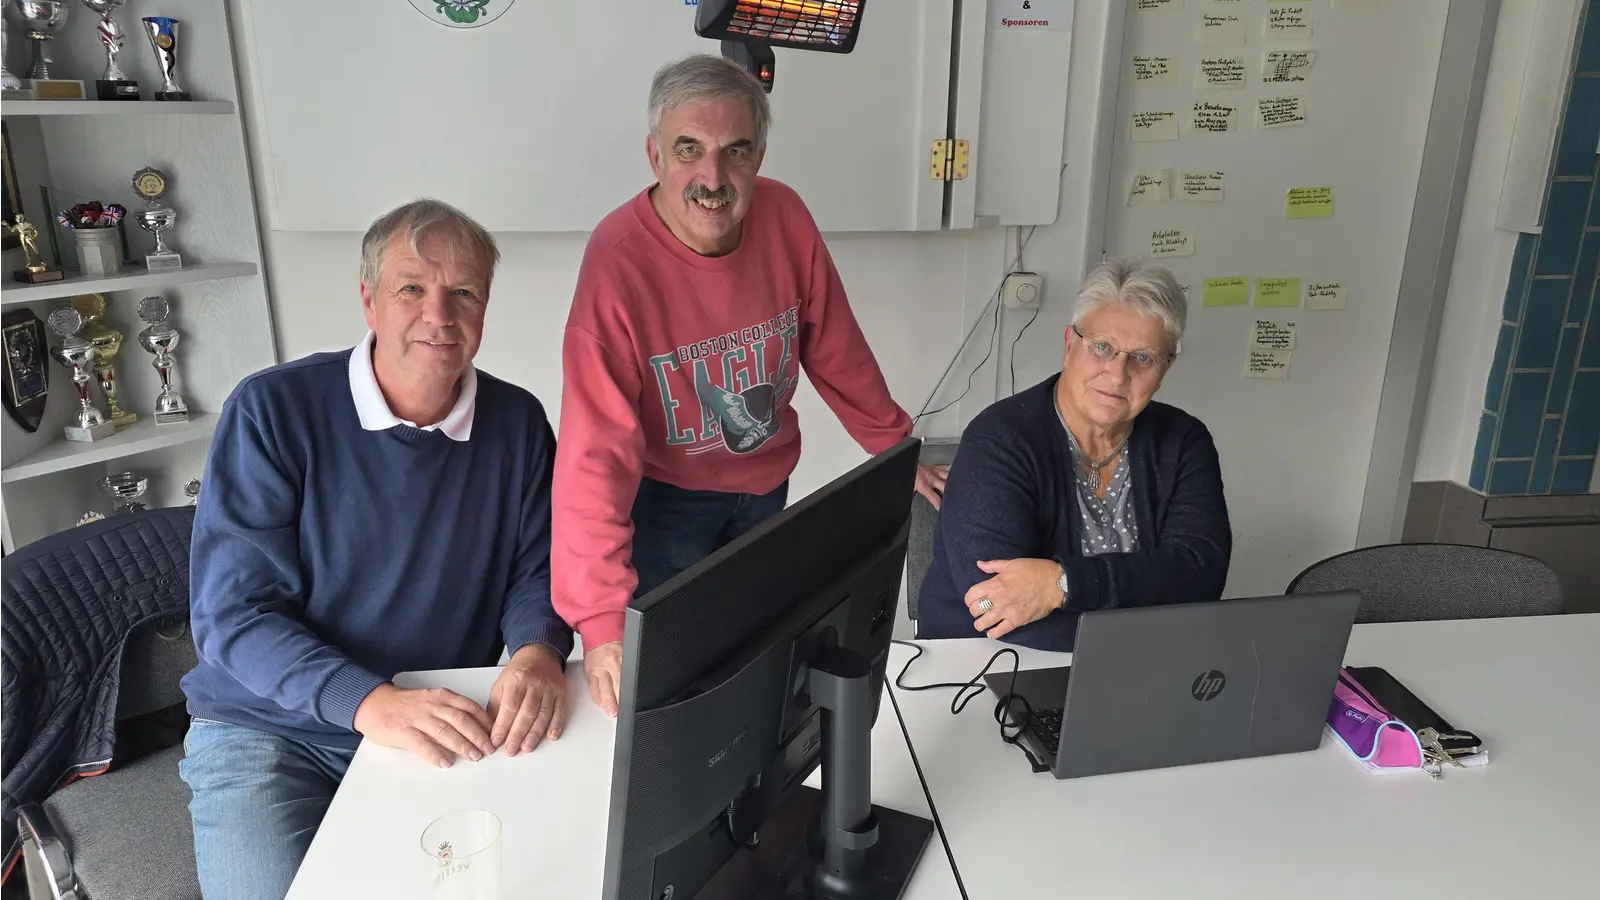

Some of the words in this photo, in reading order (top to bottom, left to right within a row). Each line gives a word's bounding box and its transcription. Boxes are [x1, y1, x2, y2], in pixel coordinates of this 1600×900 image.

[1022, 0, 1031, 10] &
[1001, 17, 1049, 28] Sponsoren
[678, 332, 740, 363] BOSTON
[1193, 669, 1224, 702] hp
